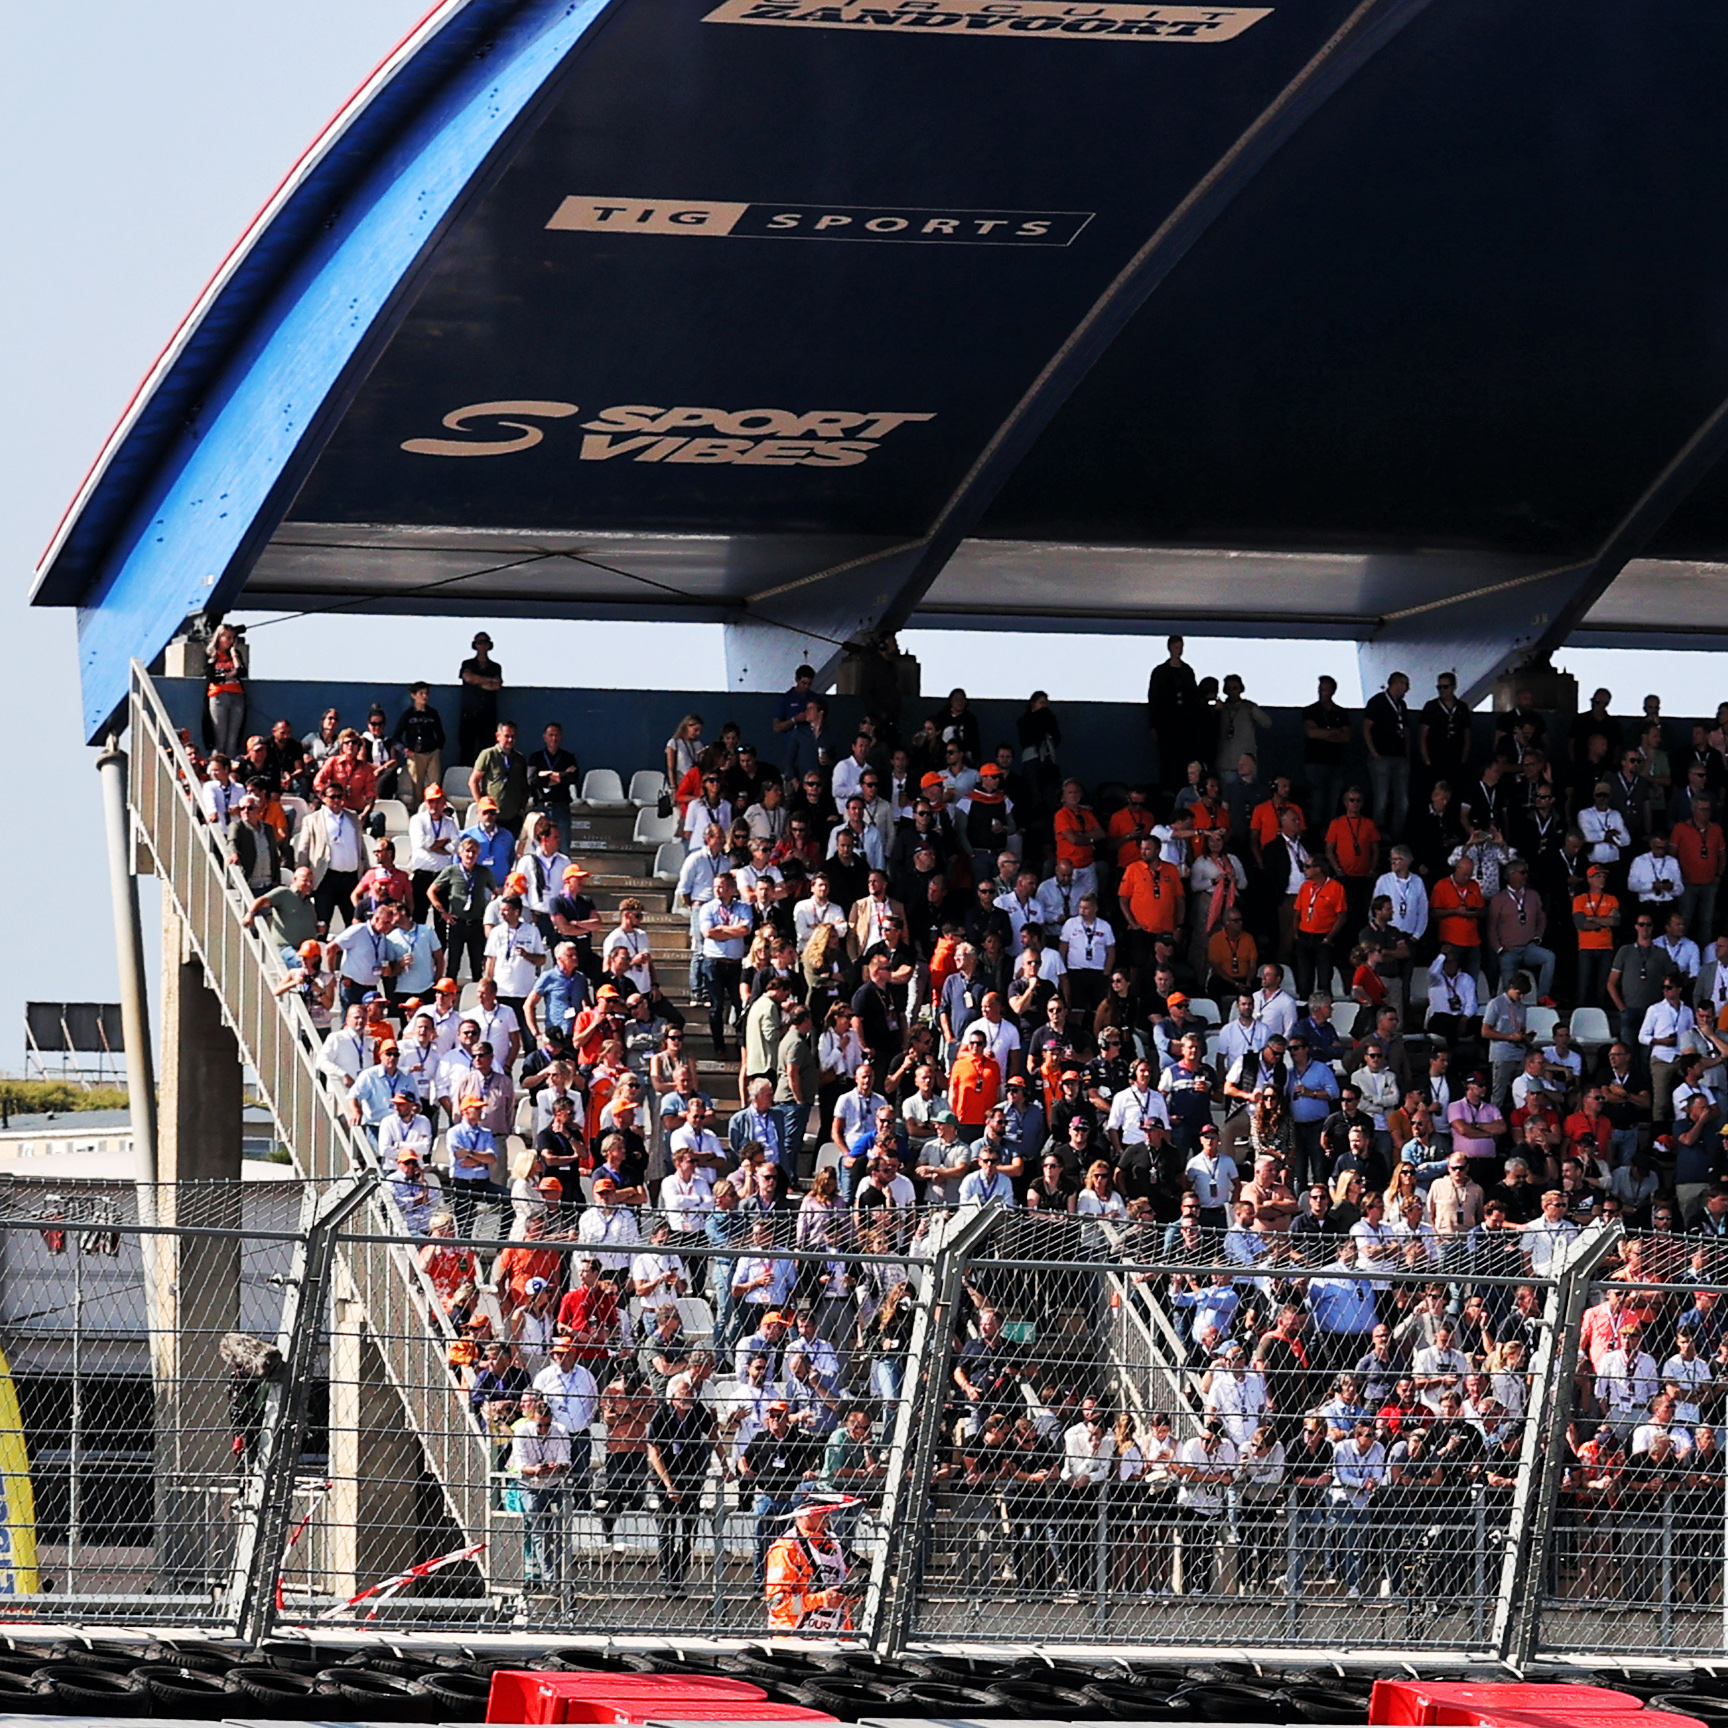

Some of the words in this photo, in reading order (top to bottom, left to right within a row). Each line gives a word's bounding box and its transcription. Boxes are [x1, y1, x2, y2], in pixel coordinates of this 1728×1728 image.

[738, 4, 1224, 36] ZANDVOORT
[592, 205, 712, 226] TIG
[766, 213, 1053, 236] SPORTS
[579, 405, 938, 439] SPORT
[579, 434, 881, 467] VIBES
